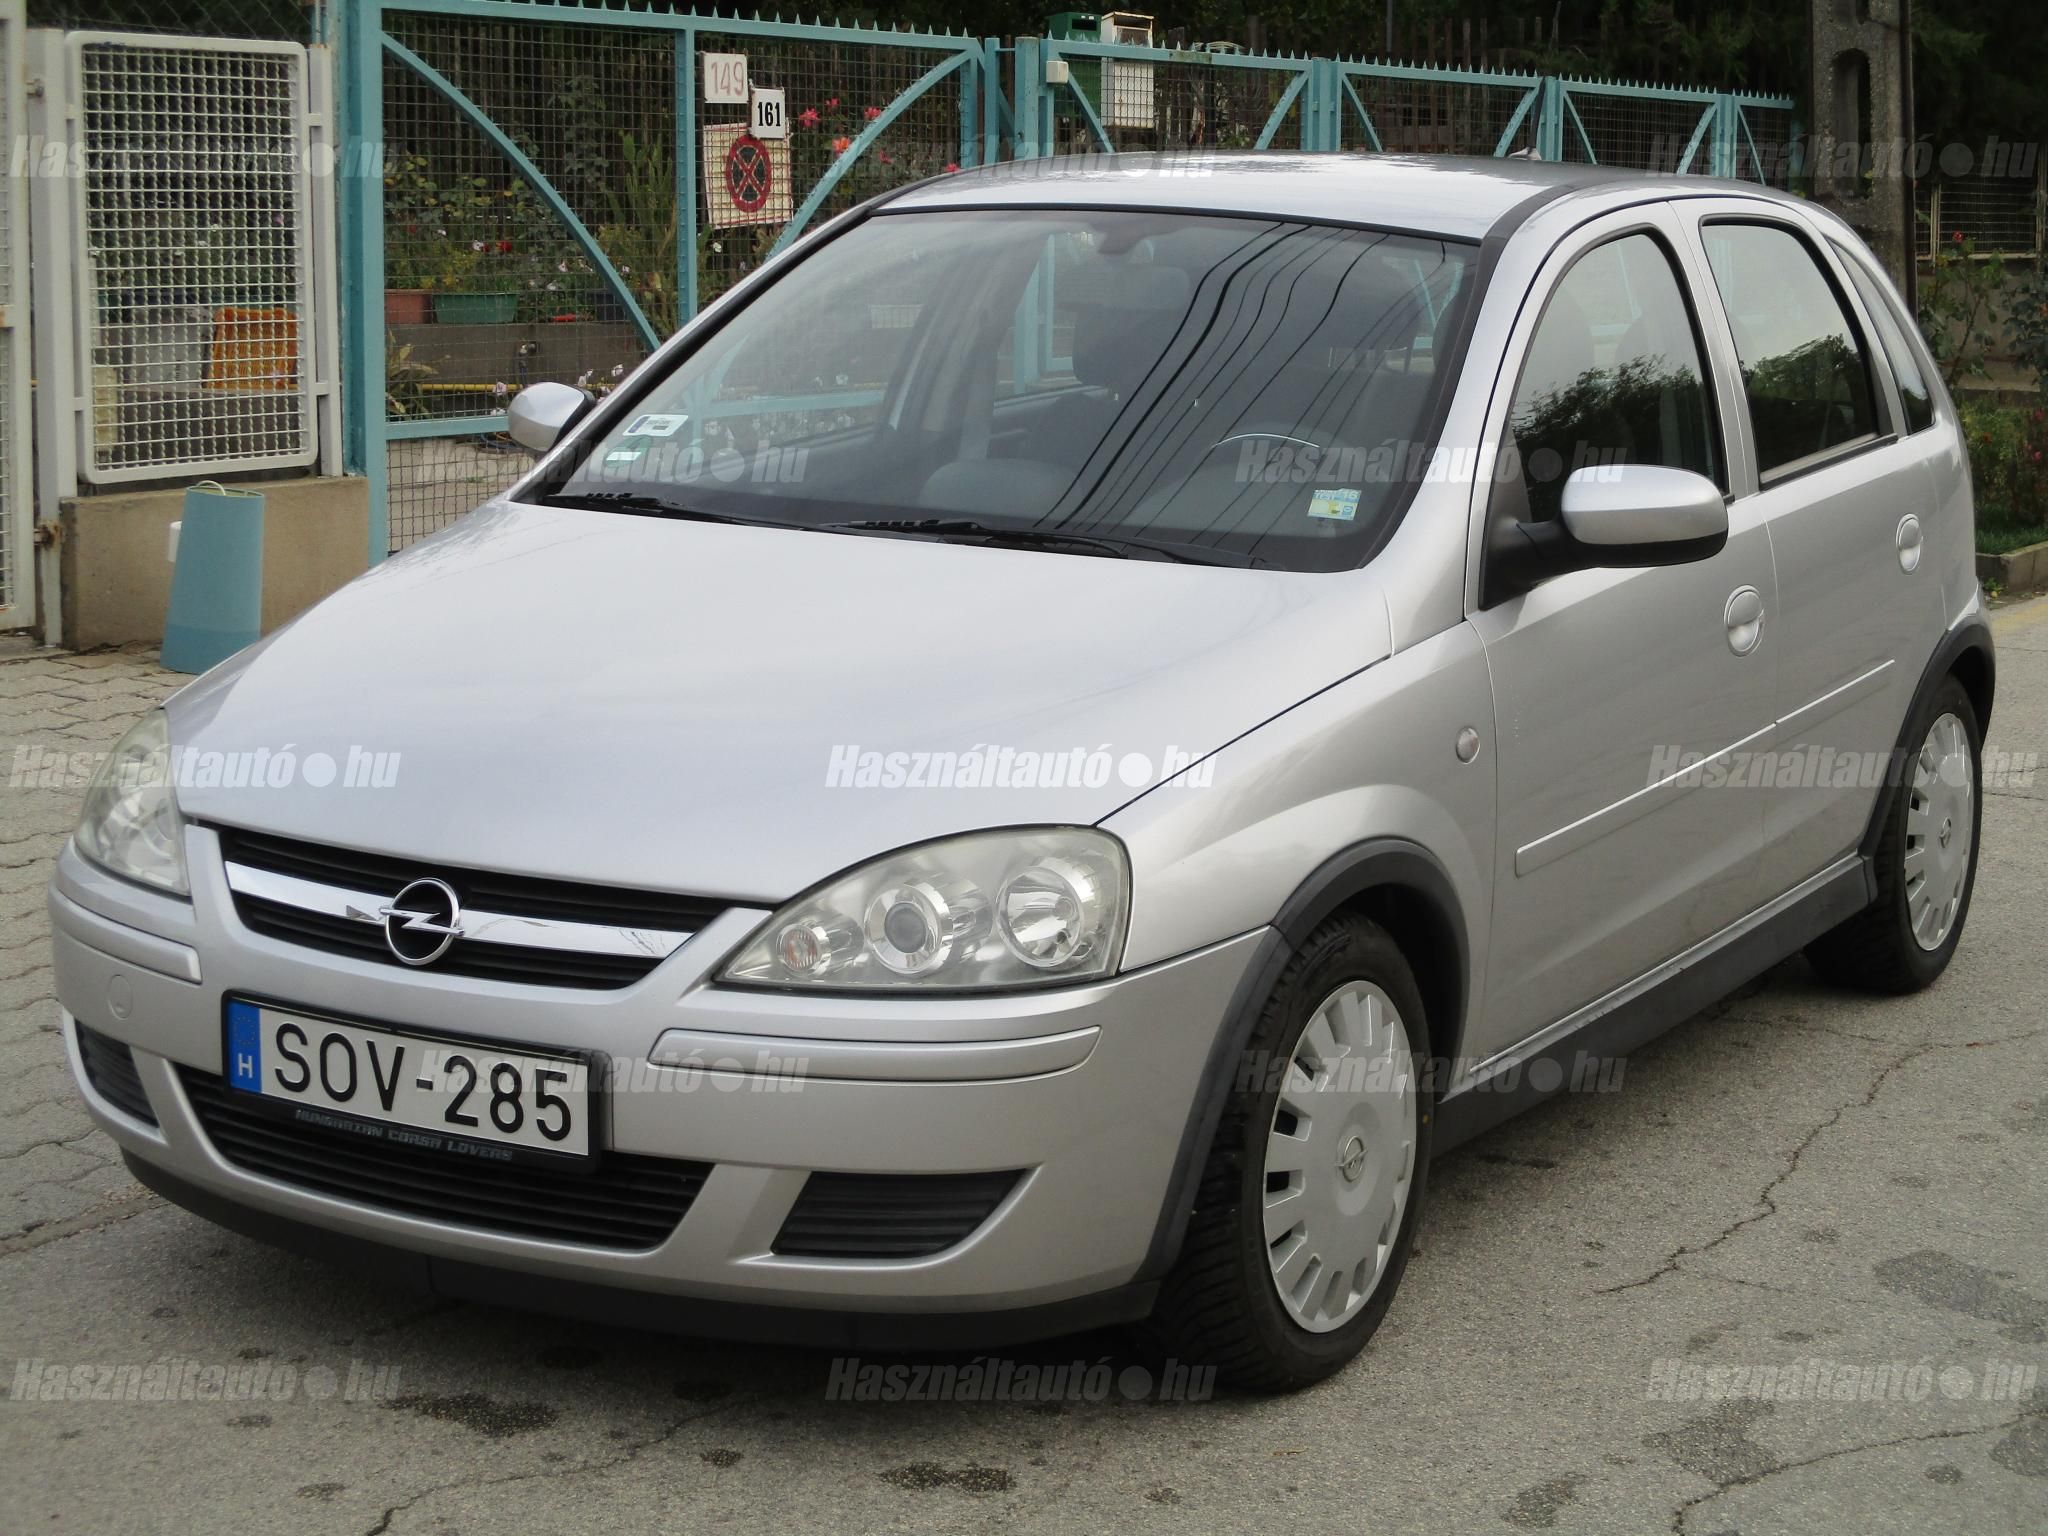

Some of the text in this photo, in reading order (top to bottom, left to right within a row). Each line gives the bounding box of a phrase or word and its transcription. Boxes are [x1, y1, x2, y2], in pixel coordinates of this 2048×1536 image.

[711, 61, 745, 97] 149
[757, 101, 781, 127] 161
[237, 1053, 254, 1079] H
[273, 1021, 573, 1143] SOV-285
[387, 1131, 443, 1150] CORSA
[447, 1140, 513, 1162] LOVERS
